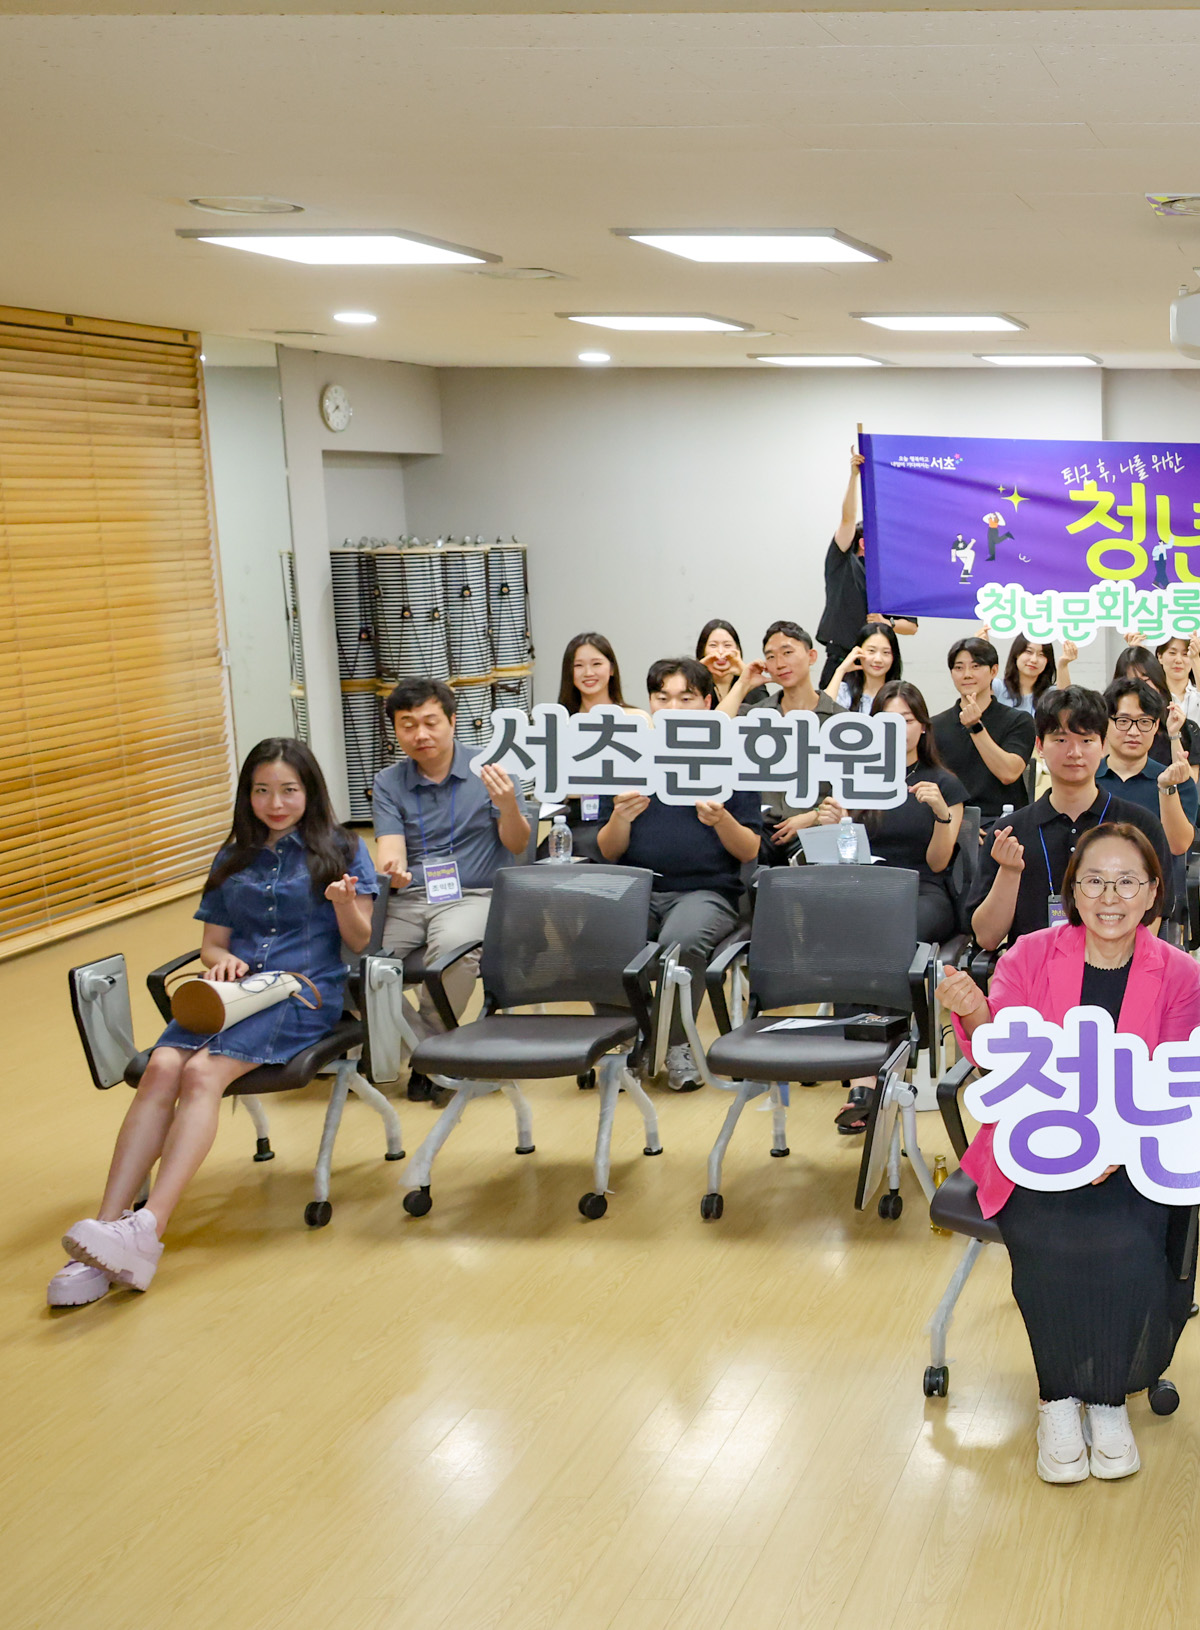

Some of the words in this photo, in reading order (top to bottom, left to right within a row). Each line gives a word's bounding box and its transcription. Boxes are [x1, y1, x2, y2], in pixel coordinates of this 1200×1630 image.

[930, 456, 957, 470] 서초
[1060, 463, 1094, 486] 퇴근
[1096, 458, 1116, 483] 후,
[1119, 454, 1149, 481] 나를
[1151, 450, 1185, 474] 위한
[480, 713, 899, 800] 서초문화원
